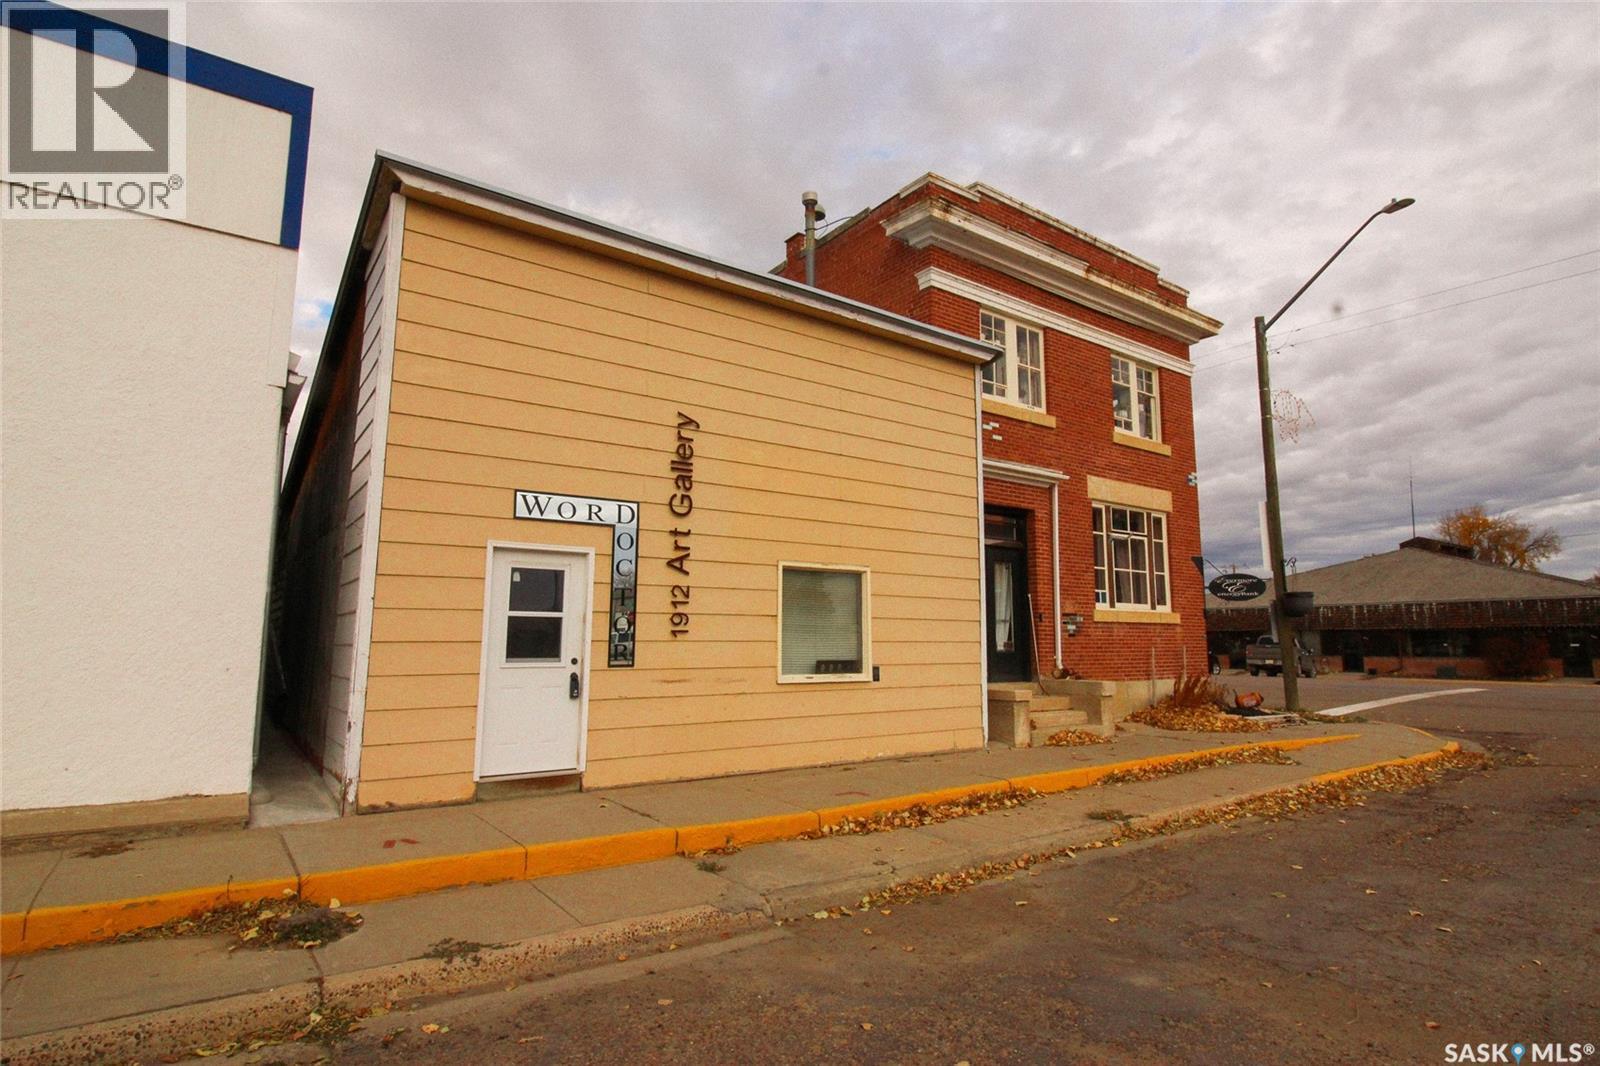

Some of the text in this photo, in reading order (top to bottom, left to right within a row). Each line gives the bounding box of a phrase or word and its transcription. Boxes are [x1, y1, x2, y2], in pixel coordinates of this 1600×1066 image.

[666, 411, 701, 638] 1912 Art Gallery
